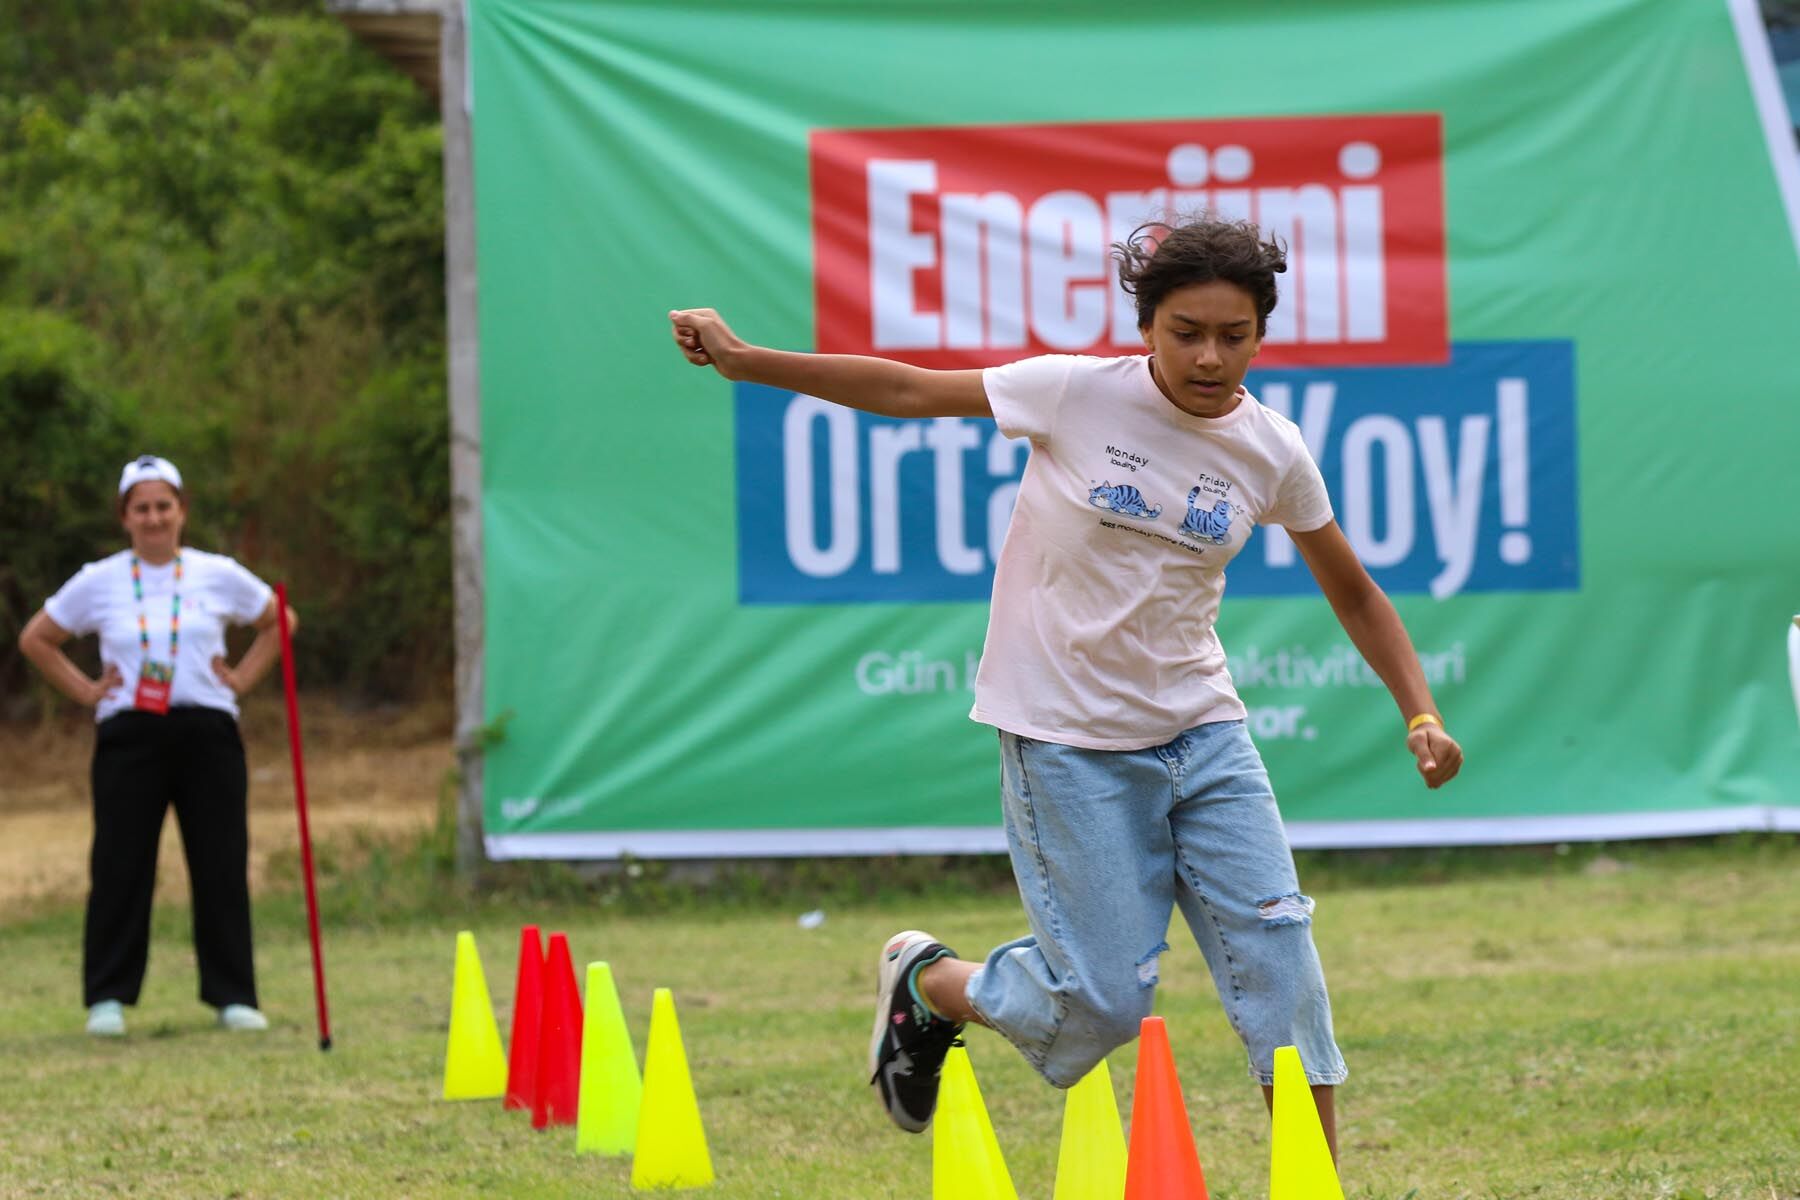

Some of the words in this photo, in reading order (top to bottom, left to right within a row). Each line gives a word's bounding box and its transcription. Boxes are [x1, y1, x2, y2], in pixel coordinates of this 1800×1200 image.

[1105, 445, 1149, 467] Monday
[1199, 473, 1232, 491] Friday
[1099, 518, 1116, 529] less
[1117, 524, 1152, 538] monday
[1153, 532, 1177, 545] more
[1178, 540, 1205, 555] friday
[855, 650, 955, 695] Gün
